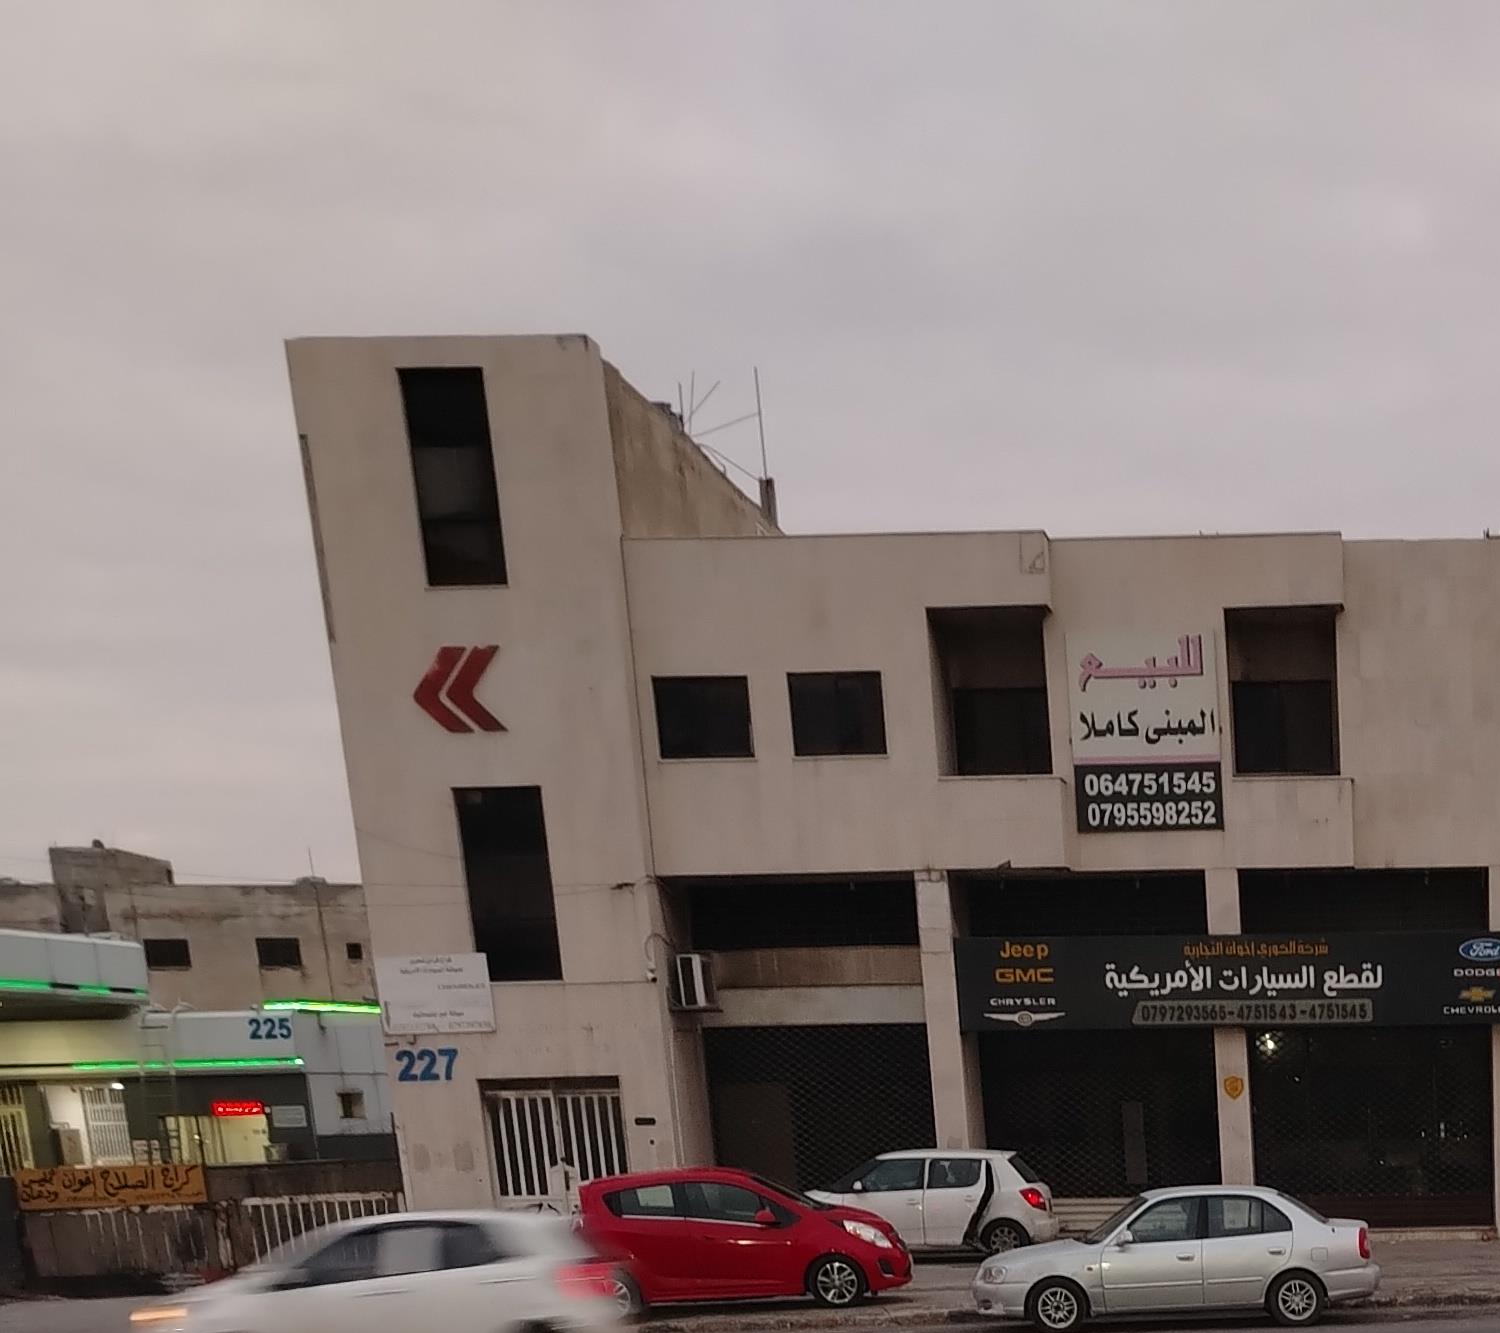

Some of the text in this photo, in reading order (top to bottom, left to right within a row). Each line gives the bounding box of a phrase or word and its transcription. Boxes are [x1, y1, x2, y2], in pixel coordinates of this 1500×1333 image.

[1079, 634, 1204, 692] للبيع
[1080, 709, 1215, 744] المبنى كاملا
[1084, 771, 1216, 796] 064751545
[1087, 801, 1217, 826] 0795598252
[1000, 941, 1049, 960] Jeep
[1469, 942, 1500, 957] Ford
[995, 968, 1055, 984] GMC
[1105, 960, 1383, 997] لقطع السيارات الأمريكية
[990, 998, 1057, 1007] CHRYSLER
[248, 1018, 292, 1039] 225
[395, 1048, 459, 1082] 227
[101, 1169, 156, 1197] الصلاح
[162, 1164, 199, 1193] كراج
